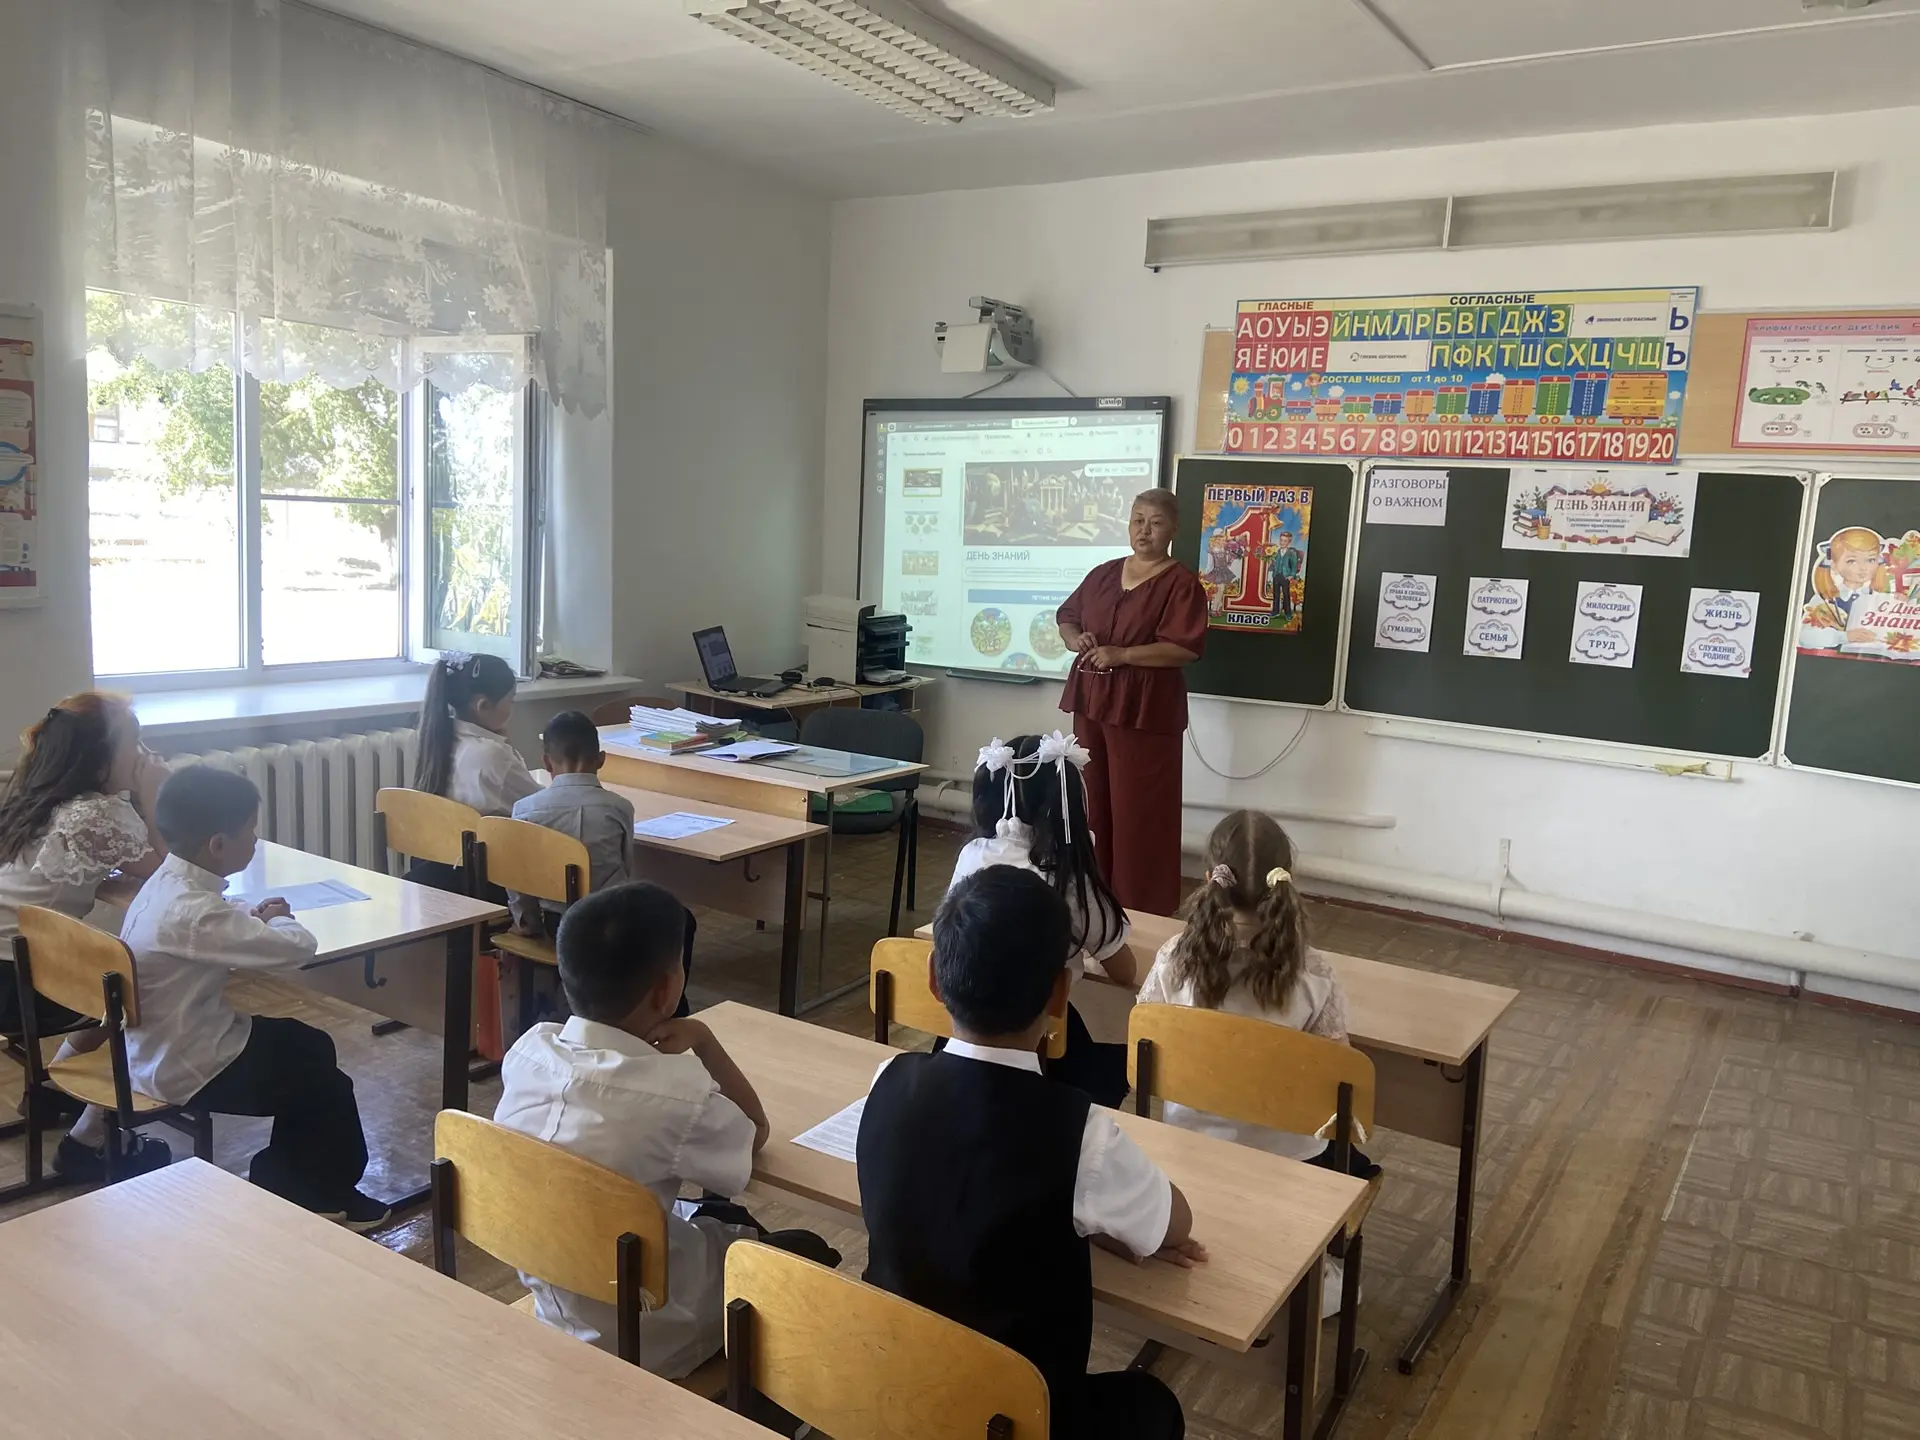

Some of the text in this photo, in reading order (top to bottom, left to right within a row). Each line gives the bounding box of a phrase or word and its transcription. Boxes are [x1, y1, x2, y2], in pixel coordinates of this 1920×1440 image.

[1257, 301, 1315, 311] ГЛАСНЫЕ
[1449, 294, 1536, 306] СОГЛАСНЫЕ
[1769, 355, 1775, 364] 3
[1793, 355, 1800, 364] 2
[1817, 355, 1824, 364] 5
[1864, 355, 1871, 364] 7
[1889, 355, 1895, 364] 3
[1322, 375, 1362, 384] СОСТАВ
[1366, 375, 1400, 384] ЧИСЕЛ
[1426, 375, 1431, 383] 1
[1434, 376, 1447, 384] до
[1451, 375, 1463, 383] 10
[1228, 427, 1675, 459] 0 1 2 3 4 5 6 7 8 9 10 11 12 13 14 15 16 17 18 19 20
[1372, 477, 1447, 490] РАЗГОВОРЫ
[1208, 487, 1309, 503] ПЕРВЫЙ РАЗ В
[1372, 496, 1443, 508] О ВАЖНОМ
[966, 549, 1030, 561] ДЕНЬ ЗНАНИЙ
[1223, 505, 1274, 612] 1
[1477, 596, 1518, 605] ПАТРИОТИЗМ
[1586, 601, 1631, 612] МИЛОСЕРДИЕ
[1877, 600, 1890, 613] С
[1227, 613, 1270, 625] класс
[1704, 608, 1742, 620] ЖИЗНЬ
[1387, 624, 1422, 634] ГУМАНИЗМ
[1479, 632, 1508, 642] СЕМЬЯ
[1589, 639, 1616, 650] ТРУД
[1698, 643, 1736, 655] СЛУЖЕНИЕ
[1702, 651, 1730, 661] РОДИНЕ
